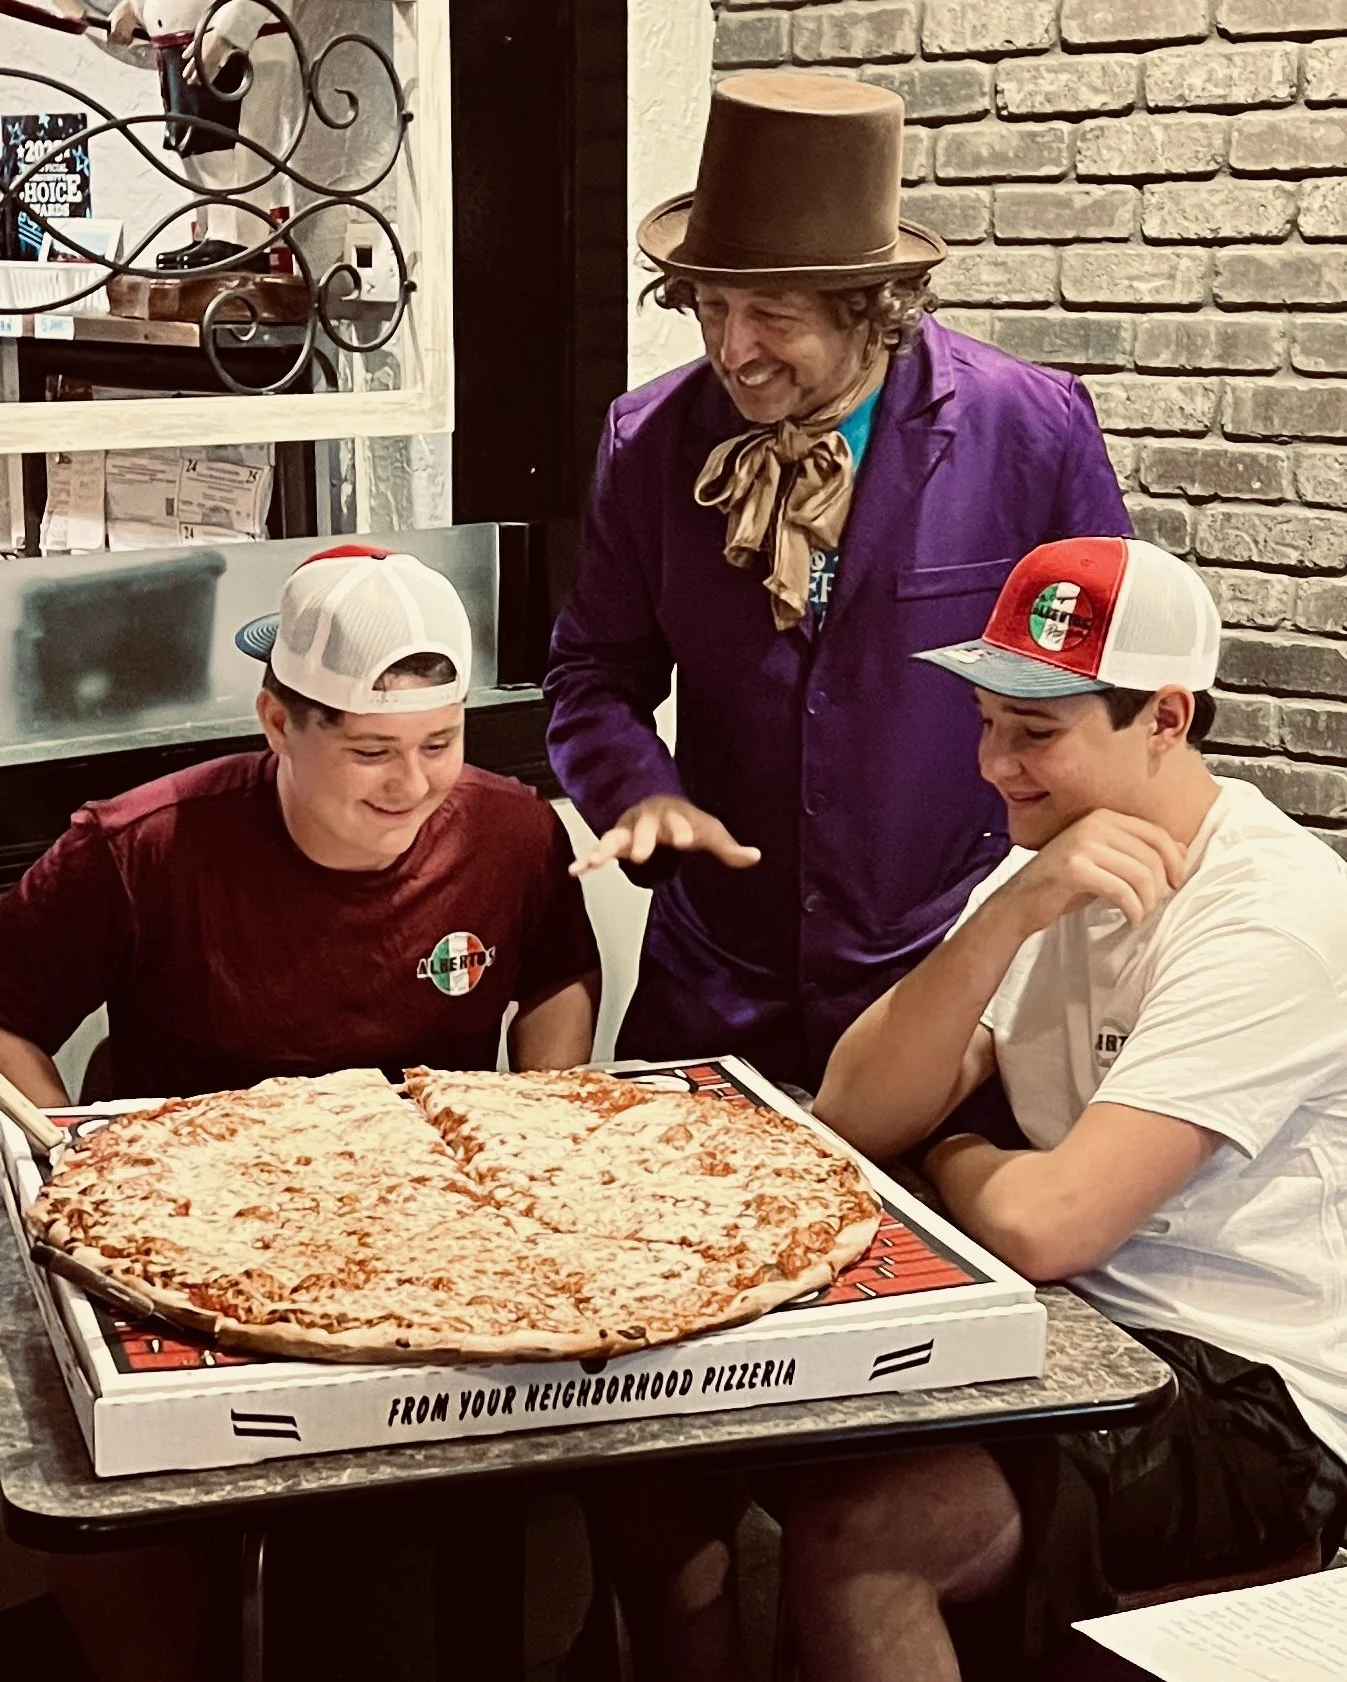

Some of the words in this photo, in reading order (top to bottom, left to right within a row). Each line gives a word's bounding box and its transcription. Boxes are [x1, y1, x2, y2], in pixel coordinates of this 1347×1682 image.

[388, 1392, 449, 1427] FROM
[459, 1385, 517, 1421] YOUR
[525, 1368, 694, 1412] NEIGHBORHOOD
[702, 1358, 796, 1394] PIZZERIA
